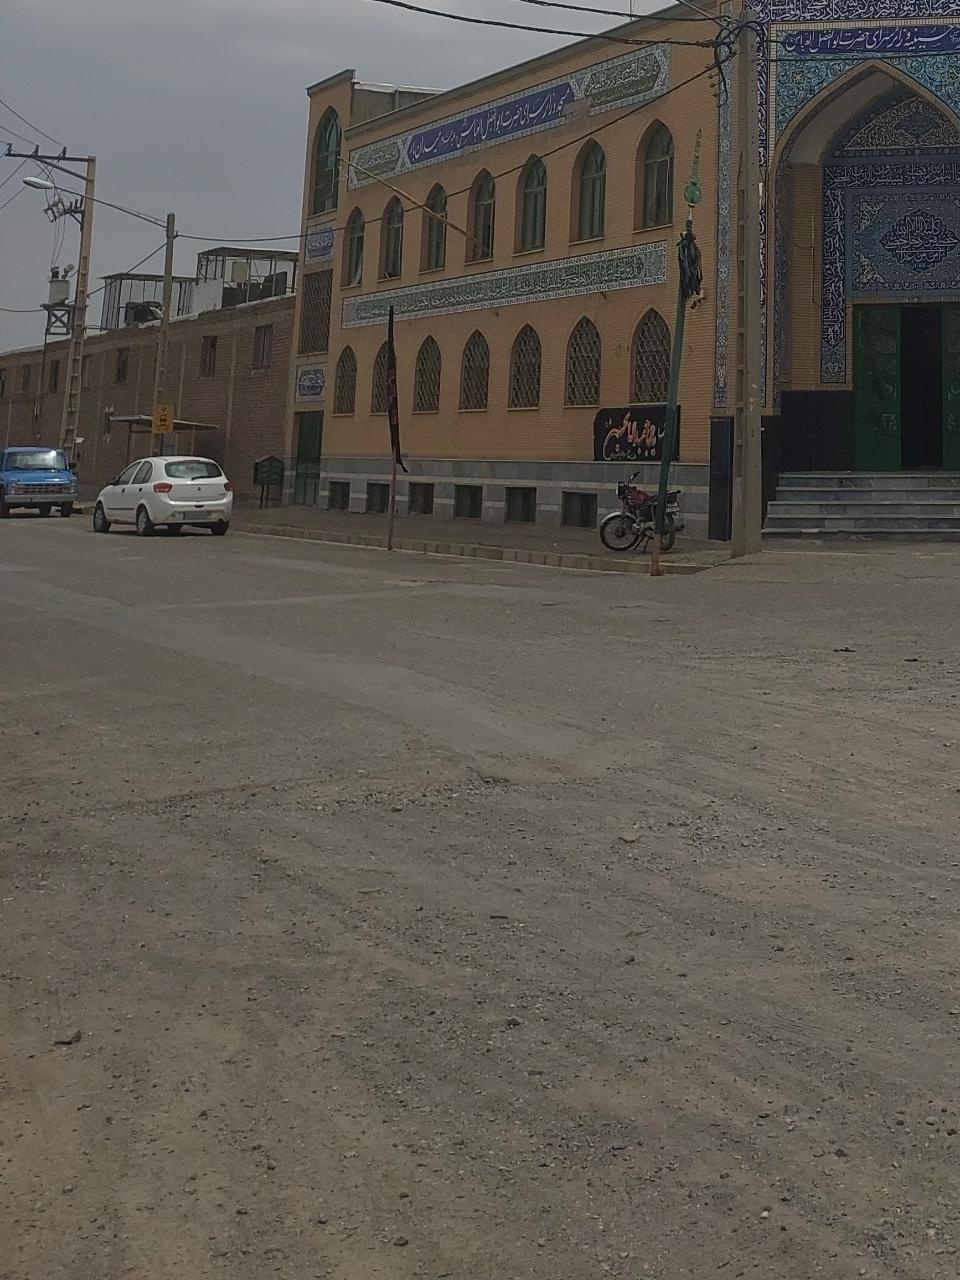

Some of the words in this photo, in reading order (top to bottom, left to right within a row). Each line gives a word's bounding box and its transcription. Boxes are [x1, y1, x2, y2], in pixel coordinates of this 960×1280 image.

[809, 30, 844, 53] ابوالفضل
[840, 30, 871, 50] حضرت
[903, 24, 955, 51] حسینیه
